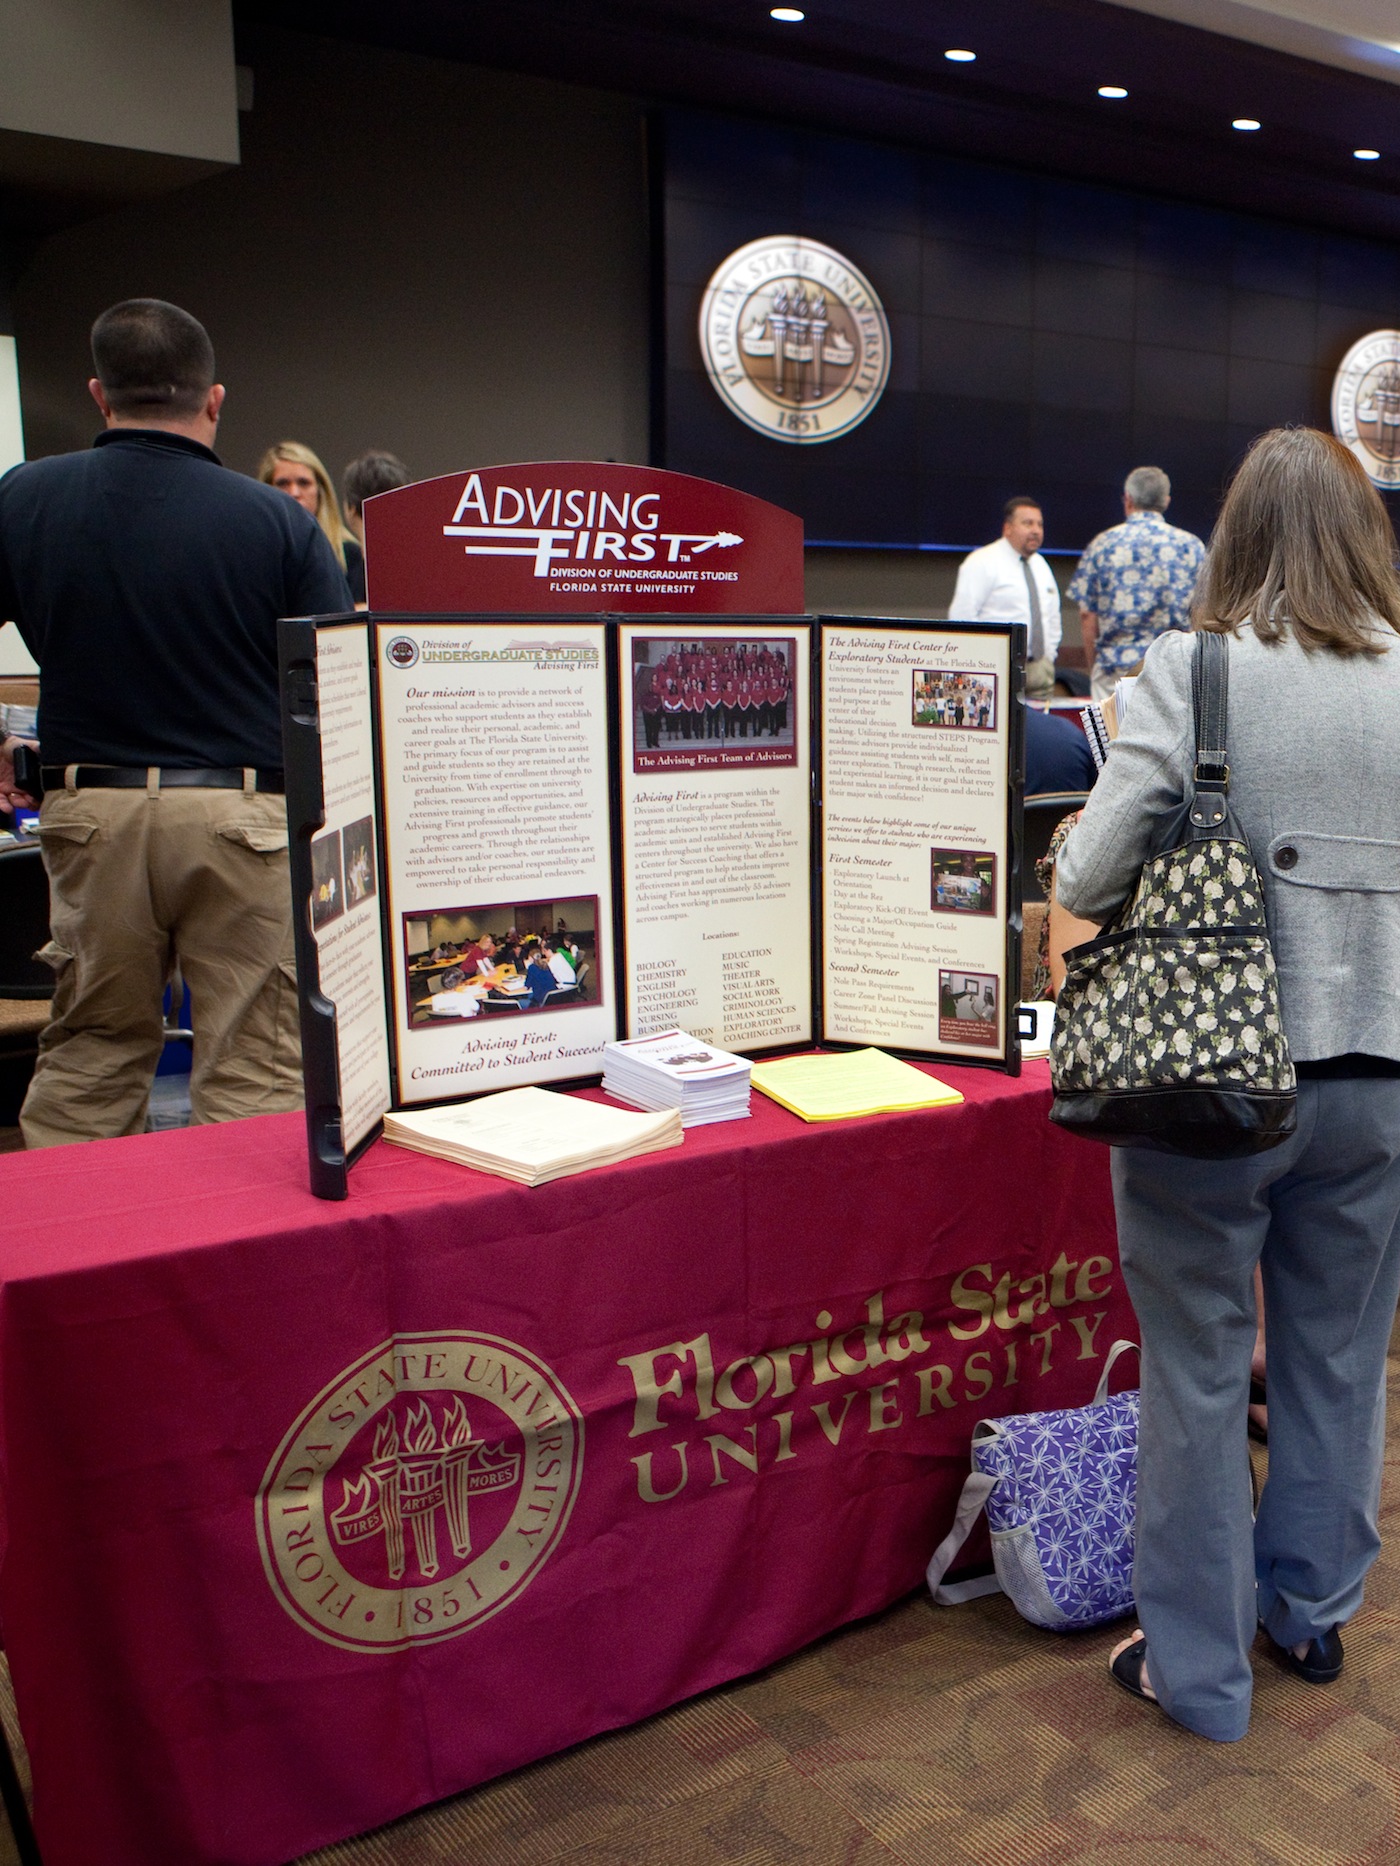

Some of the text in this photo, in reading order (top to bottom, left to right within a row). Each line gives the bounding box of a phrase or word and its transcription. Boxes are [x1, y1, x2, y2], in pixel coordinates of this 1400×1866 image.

[778, 412, 821, 430] 1851
[452, 474, 661, 531] ADVISING
[444, 525, 744, 577] FIRST
[550, 568, 738, 581] DIVISION OF UNDERGRADUATE STUDIES
[550, 583, 695, 593] FLORIDA STATE UNIVERSITY
[422, 640, 473, 650] Division of
[829, 637, 959, 654] The Advising First Center for
[423, 650, 599, 660] UNDERGRADUATE STUDIES
[829, 651, 883, 664] Exploratory
[886, 654, 925, 665] Students
[935, 658, 948, 666] The
[951, 659, 976, 668] Florida
[978, 660, 996, 669] State
[533, 661, 599, 671] Advising First
[829, 665, 864, 675] University
[866, 666, 889, 674] fosters
[407, 688, 430, 698] Our
[433, 687, 475, 698] mission
[498, 688, 529, 698] provide
[539, 687, 572, 695] network
[573, 687, 583, 695] of
[406, 702, 457, 712] professional
[460, 701, 499, 709] academic
[502, 700, 535, 708] advisors
[398, 715, 431, 723] coaches
[455, 714, 488, 722] support
[490, 713, 525, 721] students
[538, 711, 555, 721] they
[558, 710, 592, 719] establish
[412, 722, 580, 735] and realize their personal, academic, and
[405, 739, 431, 747] career
[434, 737, 456, 748] goals
[458, 737, 467, 745] at
[488, 735, 518, 744] Florida
[521, 735, 542, 743] State
[544, 734, 587, 743] University.
[638, 757, 655, 766] The
[658, 756, 695, 766] Advising
[698, 755, 717, 763] First
[720, 754, 743, 762] Team
[745, 753, 754, 761] of
[633, 792, 672, 803] Advising
[676, 791, 698, 800] First
[714, 791, 744, 800] program
[676, 803, 728, 814] Undergraduate
[829, 854, 892, 867] First Semester
[833, 869, 874, 880] Exploratory
[876, 872, 900, 881] Launch
[834, 880, 872, 889] Orientation
[834, 890, 847, 900] Day
[702, 931, 740, 940] Locations:
[722, 949, 772, 960] EDUCATION
[636, 960, 676, 971] BIOLOGY
[722, 961, 750, 971] MUSIC
[829, 962, 900, 976] Second Semester
[637, 969, 687, 982] CHEMISTRY
[723, 970, 761, 980] THEATER
[637, 981, 676, 993] ENGLISH
[723, 979, 775, 991] VISUAL ARTS
[638, 988, 697, 1003] PSYCHOLOGY
[723, 988, 780, 1001] SOCIAL WORK
[638, 999, 698, 1014] ENGINEERING
[723, 998, 784, 1011] CRIMINOLOGY
[638, 1013, 677, 1025] NURSING
[724, 1006, 797, 1022] HUMAN SCIENCES
[638, 1023, 680, 1035] BUSINESS
[724, 1018, 783, 1032] EXPLORATORY
[724, 1030, 768, 1042] COACHING
[770, 1025, 801, 1036] CENTER
[462, 1033, 557, 1054] Advising First:
[411, 1041, 605, 1080] Committed to Student Success!
[617, 1251, 1113, 1438] Florida State
[630, 1312, 1107, 1503] UNIVERSITY
[469, 1469, 513, 1488] MORES
[282, 1353, 566, 1619] FLORIDA STATE UNIVERSITY
[402, 1489, 442, 1511] ARTES
[344, 1512, 380, 1537] VIRES
[398, 1577, 483, 1628] 1851
